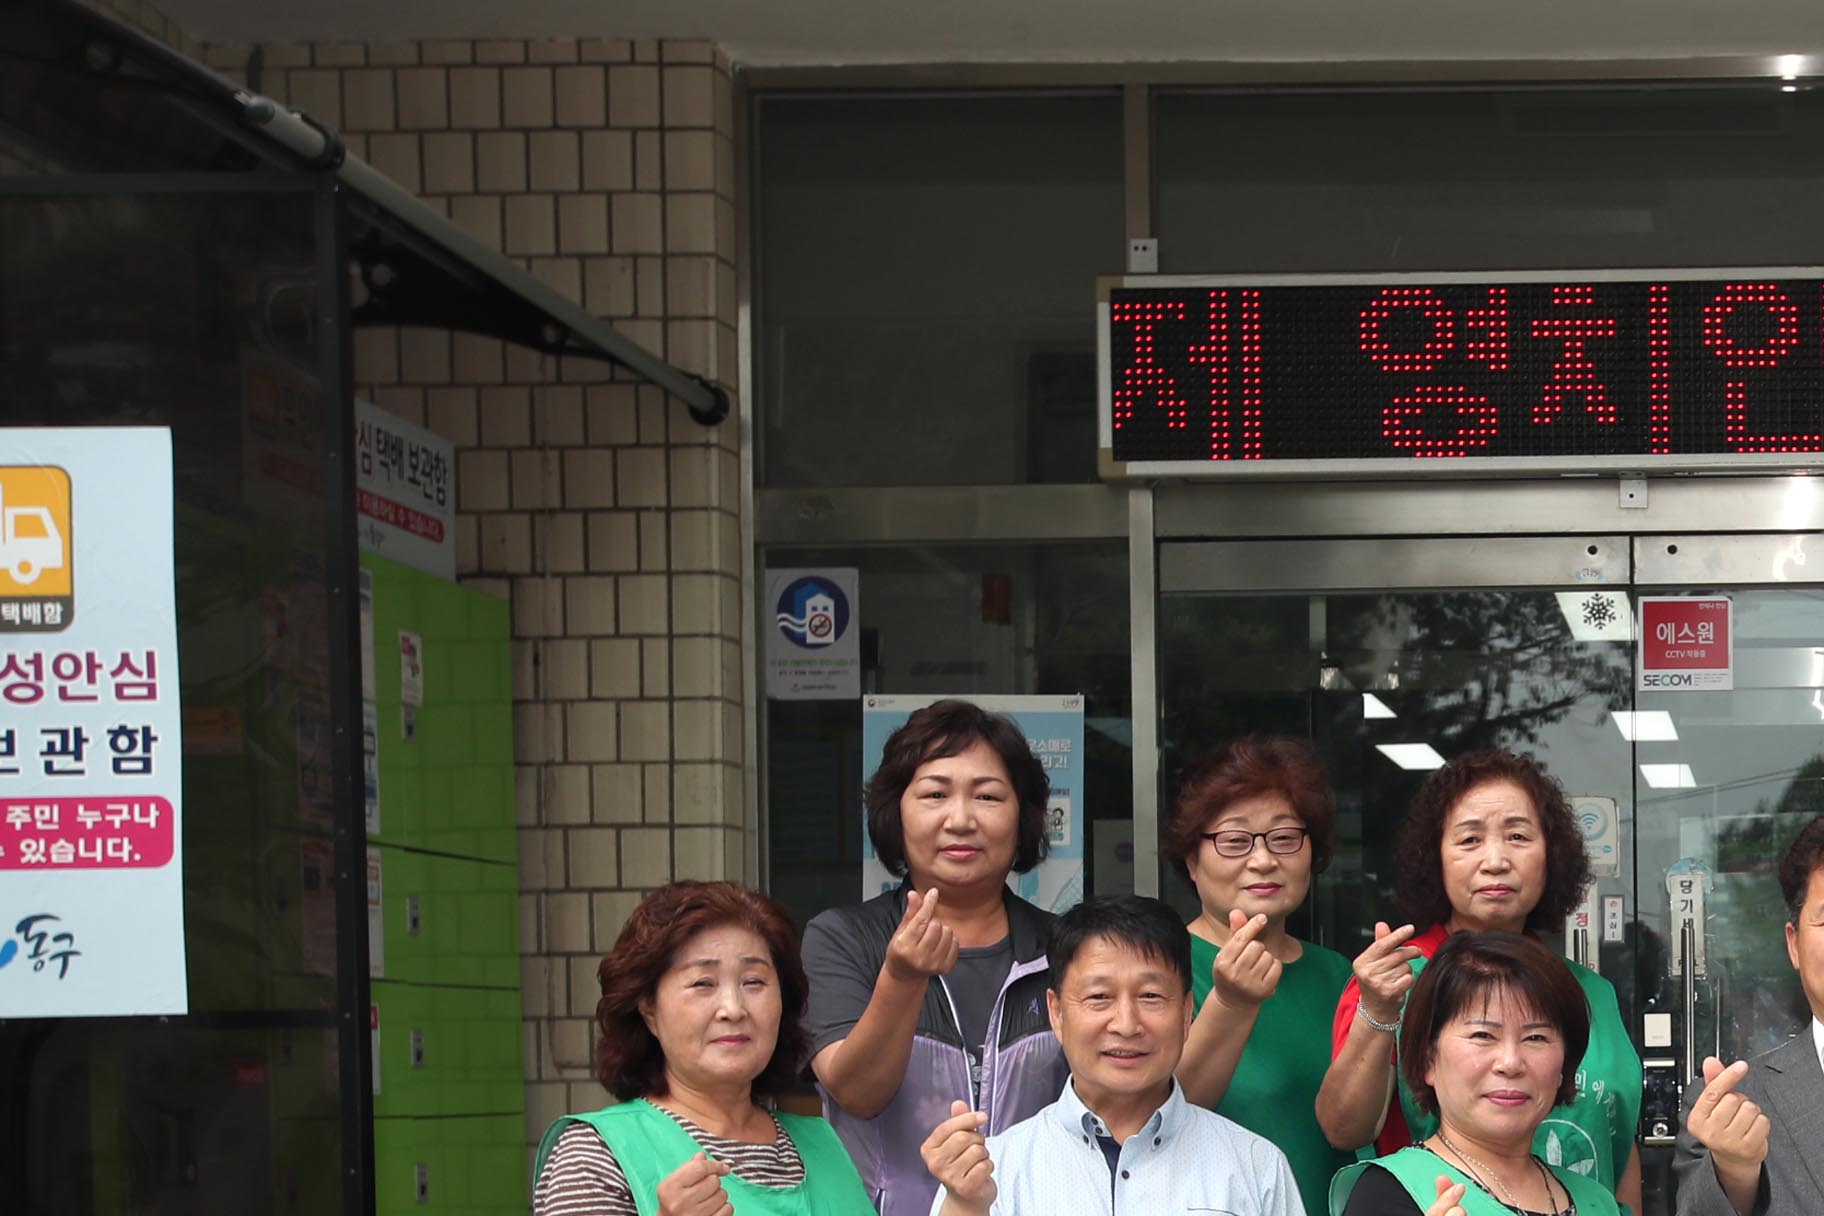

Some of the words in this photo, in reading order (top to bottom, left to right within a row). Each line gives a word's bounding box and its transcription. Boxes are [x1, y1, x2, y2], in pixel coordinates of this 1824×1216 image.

[1113, 288, 1263, 460] 제
[354, 421, 372, 476] 심
[376, 427, 405, 483] 택배
[408, 442, 447, 507] 보관함
[1656, 621, 1715, 645] 에스원
[1665, 650, 1686, 658] CCTV
[1643, 674, 1692, 687] SECOM
[1028, 738, 1073, 753] 소매로
[6, 803, 60, 829] 주민
[77, 802, 159, 829] 누구나
[20, 838, 141, 865] 있습니다.
